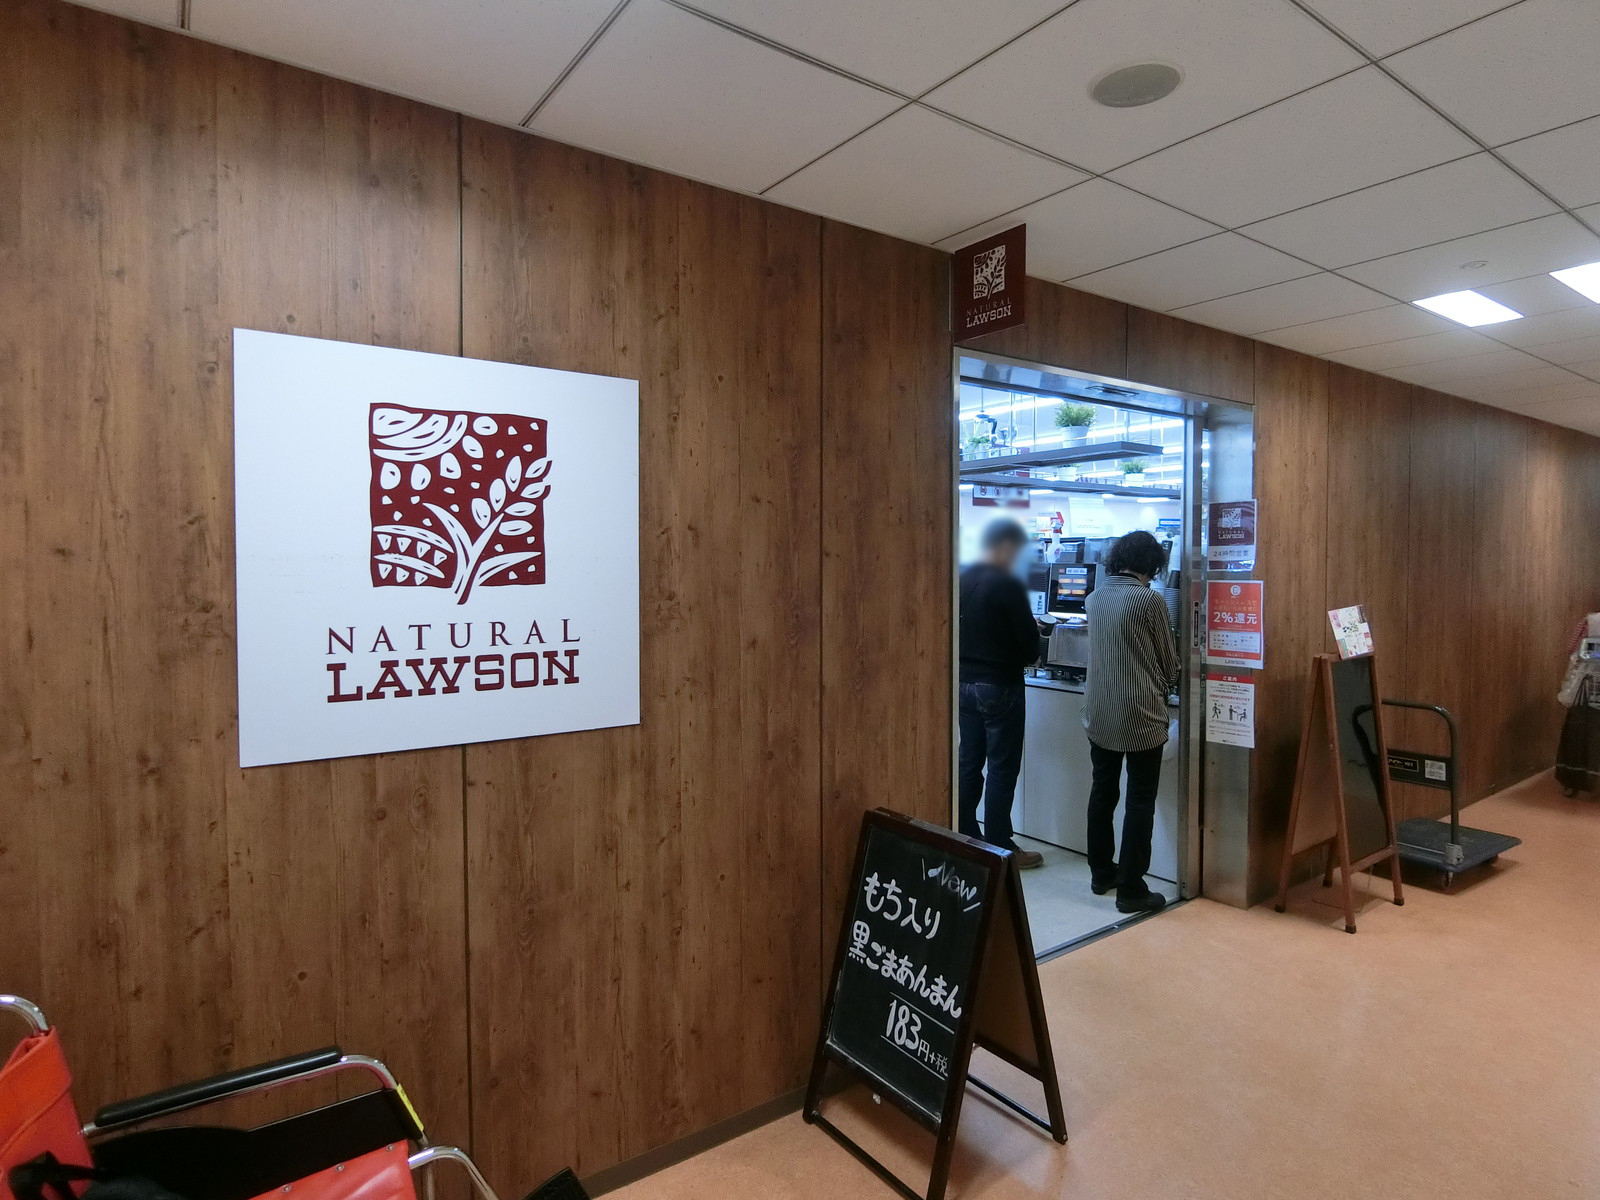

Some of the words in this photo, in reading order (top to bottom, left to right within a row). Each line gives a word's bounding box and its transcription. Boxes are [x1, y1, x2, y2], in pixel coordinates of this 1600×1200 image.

[966, 297, 1013, 317] NATURAL
[966, 304, 1012, 328] LAWSON
[325, 618, 581, 655] NATURAL
[1213, 611, 1258, 625] 2%還元
[326, 649, 580, 704] LAWSON
[863, 871, 941, 940] もち入り
[848, 919, 963, 1019] 黒ごまあんまん
